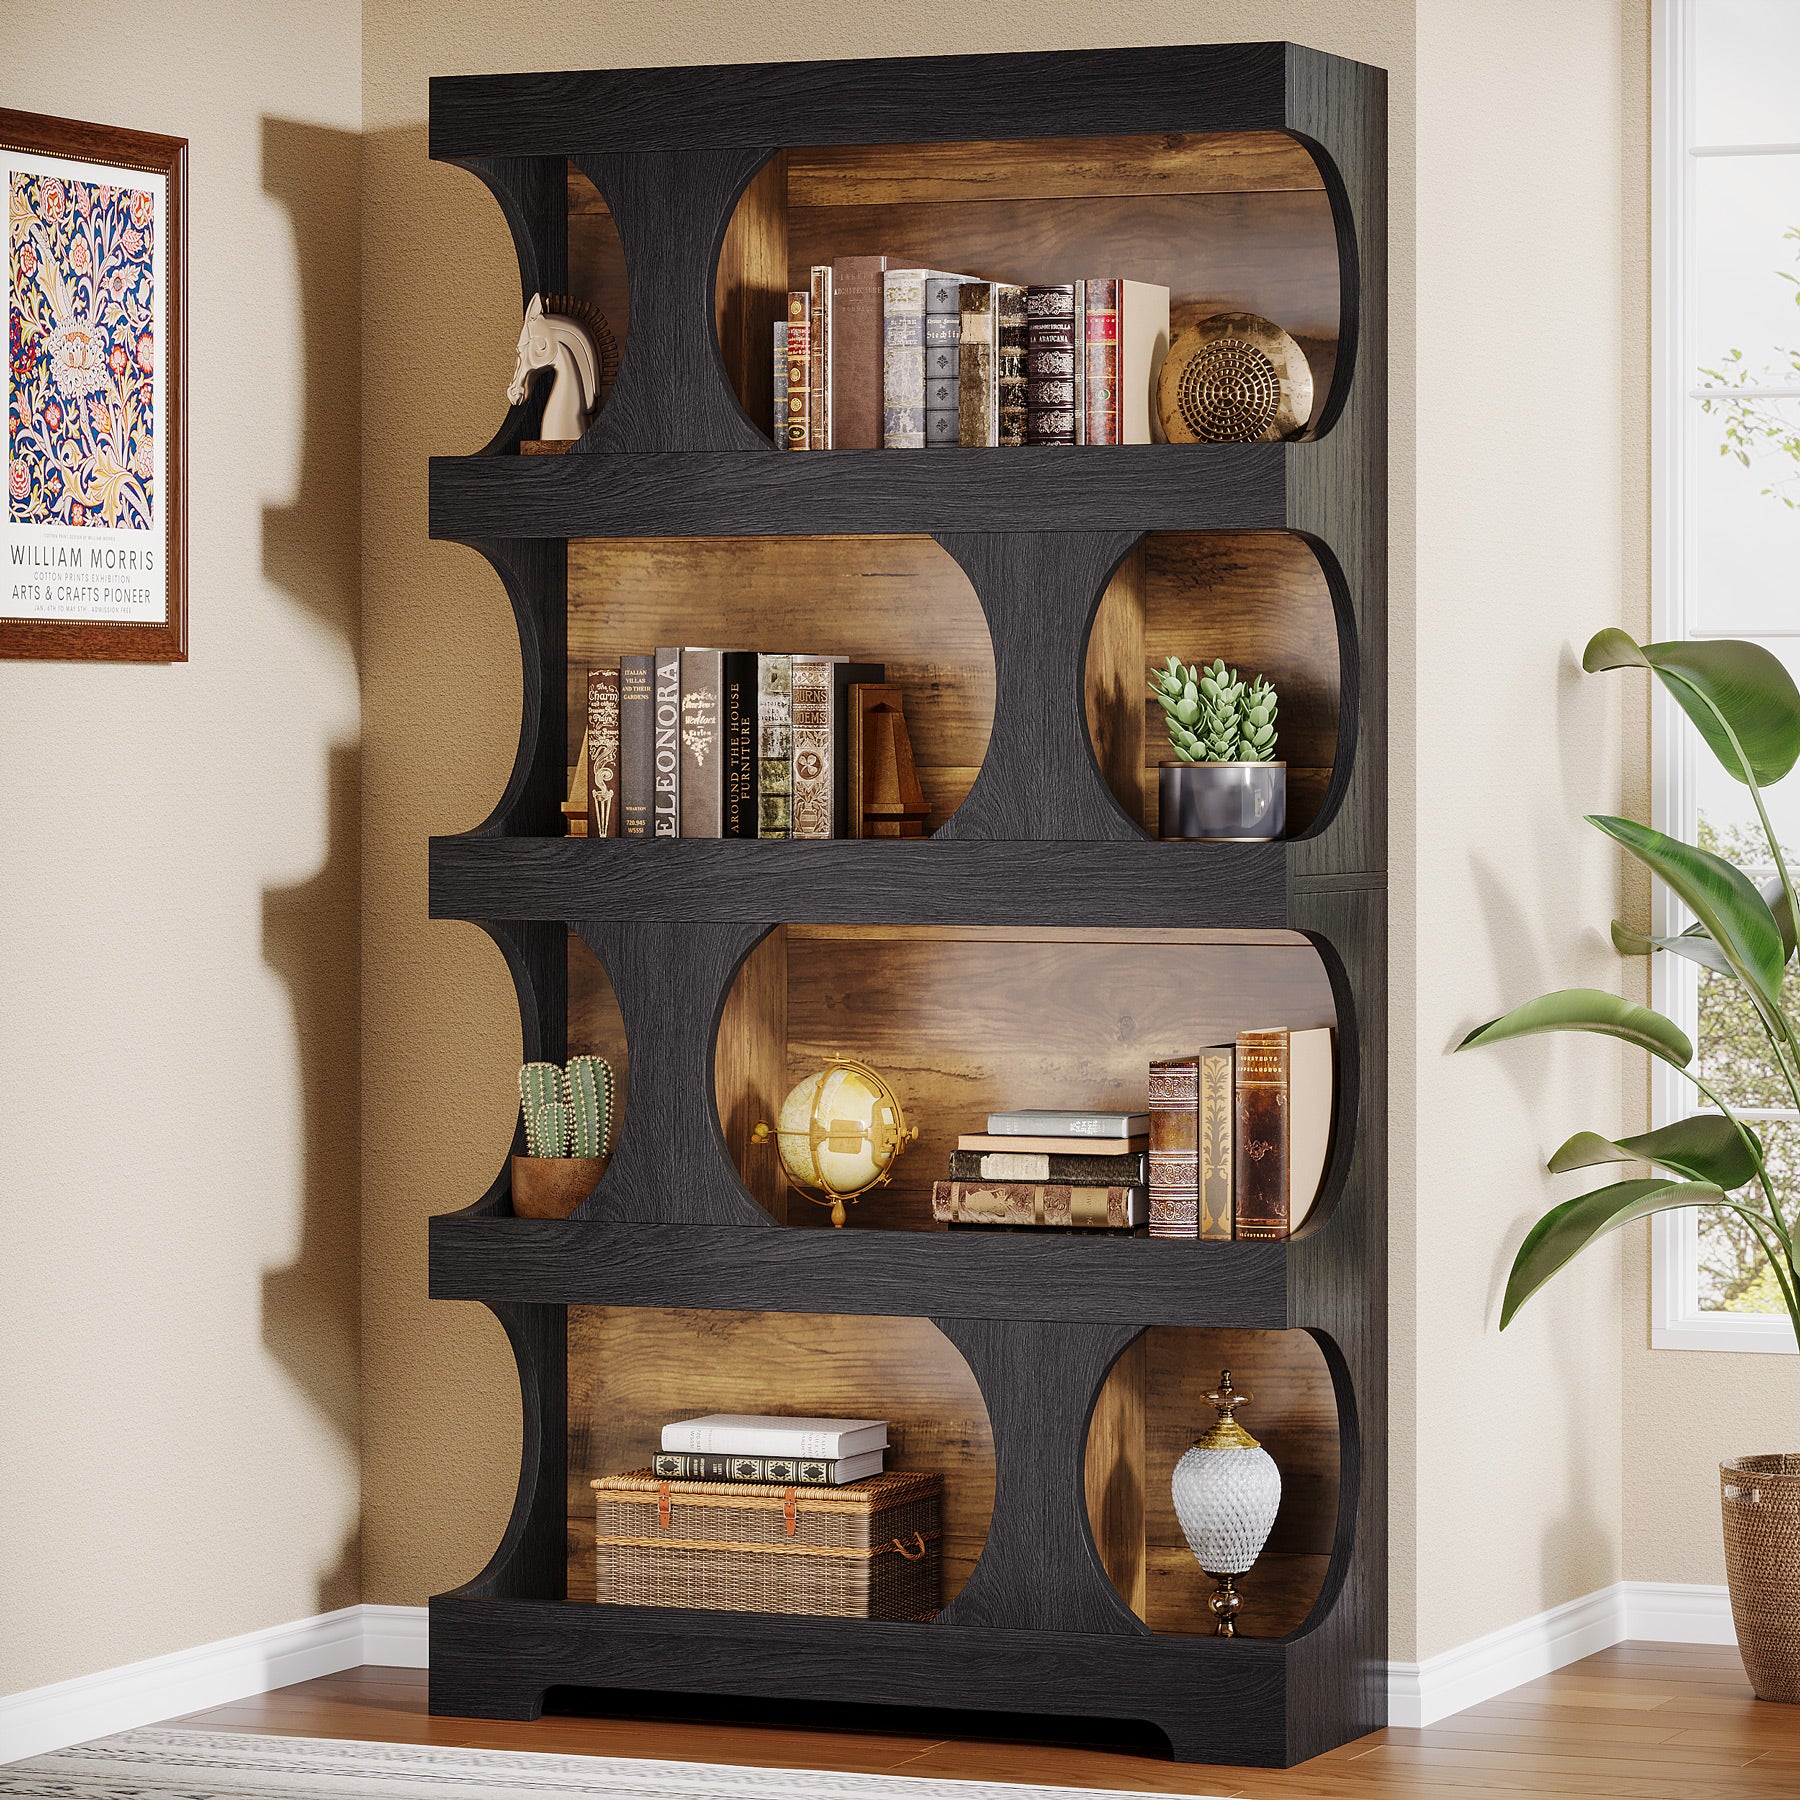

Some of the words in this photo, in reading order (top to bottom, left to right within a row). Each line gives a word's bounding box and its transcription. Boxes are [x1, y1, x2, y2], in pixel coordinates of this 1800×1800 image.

[10, 545, 82, 567] WILLIAM
[90, 548, 154, 571] MORRIS
[34, 571, 62, 581] COTTON
[64, 572, 89, 582] PRINTS
[91, 573, 130, 583] EXHIBITION
[12, 585, 41, 600] ARTS
[45, 585, 53, 601] &
[57, 586, 100, 602] CRAFTS
[104, 588, 151, 604] PIONEER
[589, 690, 618, 702] Charm
[731, 683, 739, 731] HOUSE
[793, 690, 828, 703] BURNS
[793, 711, 828, 724] POEMS
[655, 662, 678, 838] ELEONORA
[731, 737, 739, 766] THE
[741, 717, 750, 799] FURNITURE
[731, 772, 739, 833] AROUND
